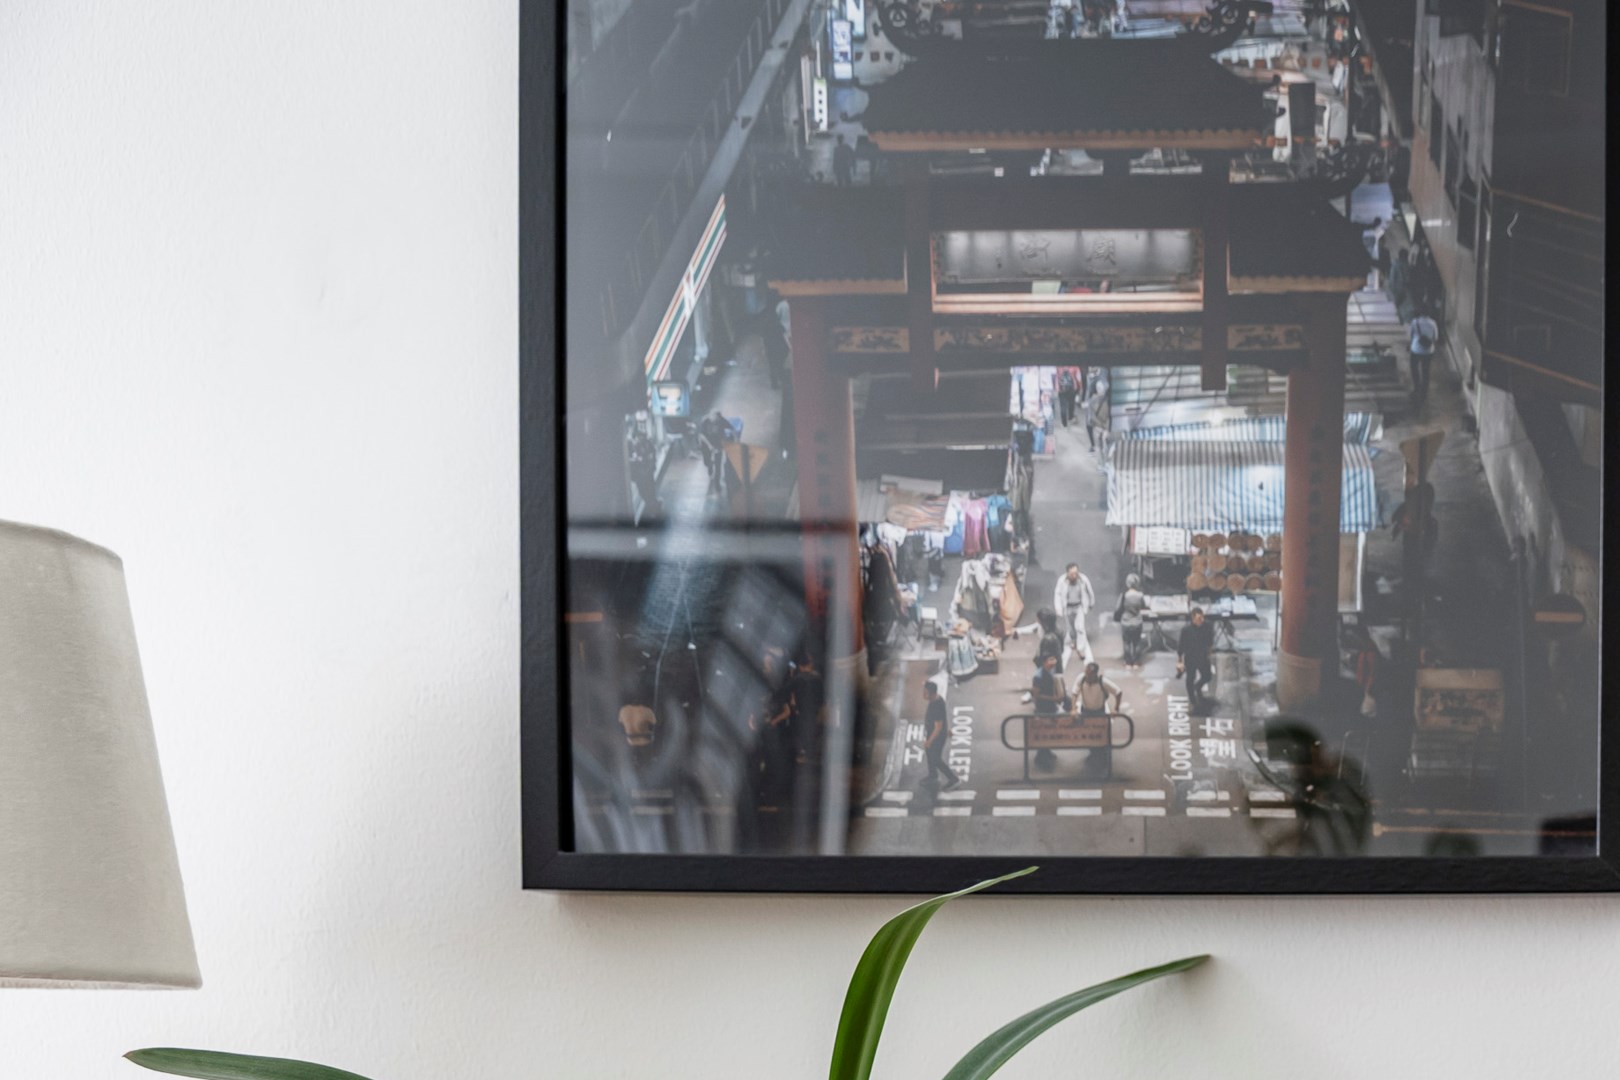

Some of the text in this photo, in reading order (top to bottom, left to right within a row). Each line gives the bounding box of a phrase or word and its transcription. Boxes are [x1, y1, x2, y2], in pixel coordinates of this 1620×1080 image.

[951, 705, 974, 746] LOOK
[1167, 694, 1193, 780] LOOK RIGHT
